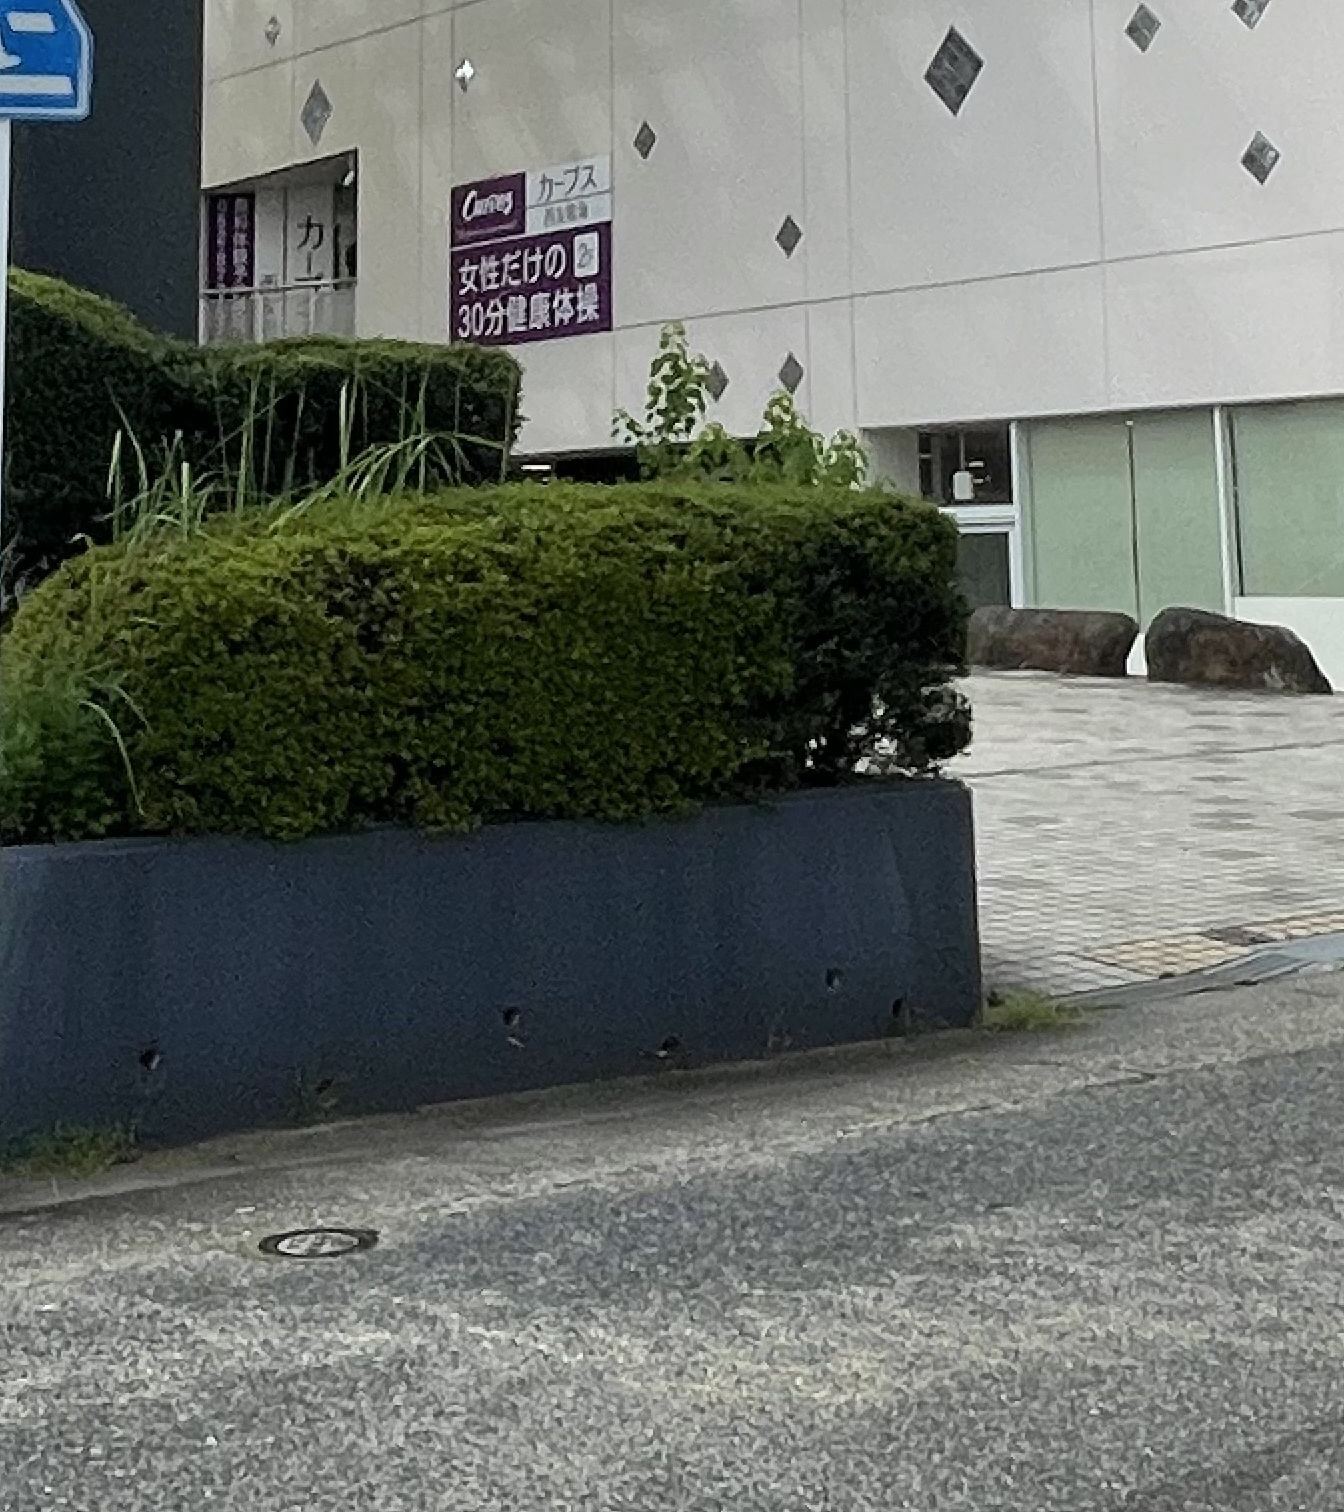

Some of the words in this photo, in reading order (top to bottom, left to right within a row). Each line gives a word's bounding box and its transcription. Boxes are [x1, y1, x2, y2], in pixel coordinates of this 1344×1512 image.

[458, 244, 566, 296] 女性だけの
